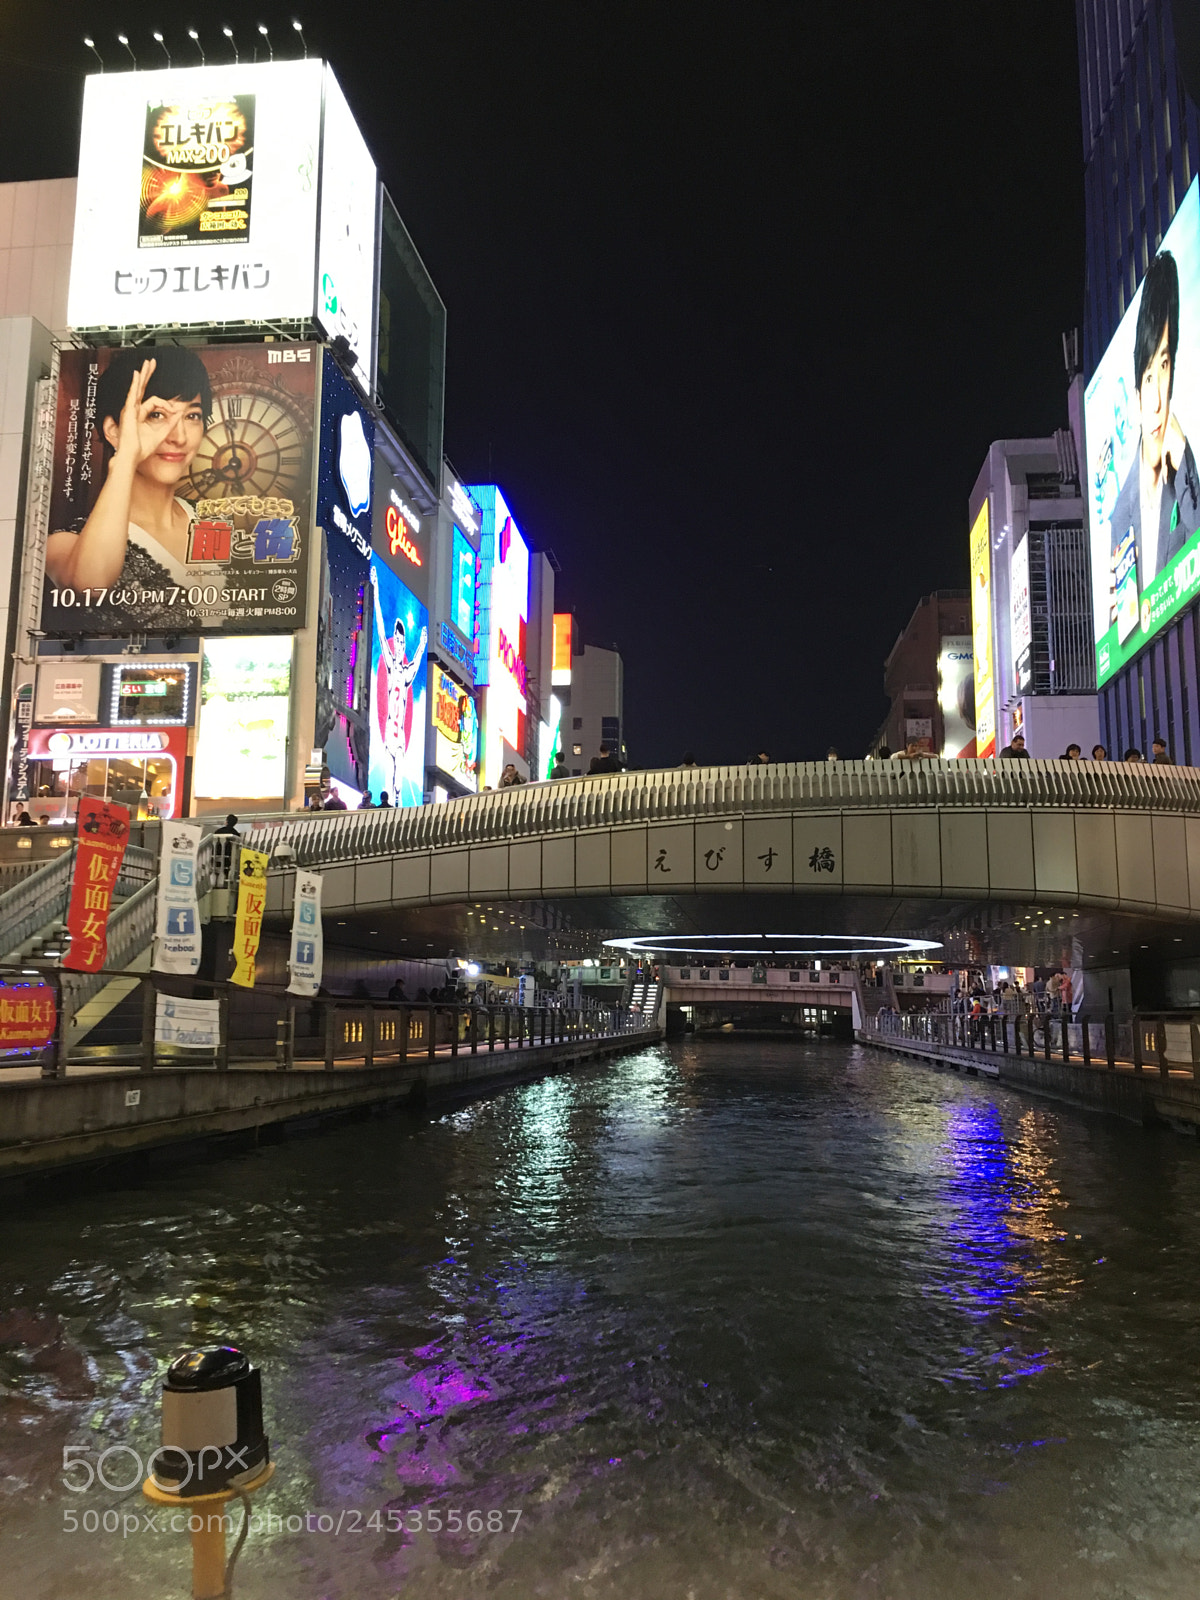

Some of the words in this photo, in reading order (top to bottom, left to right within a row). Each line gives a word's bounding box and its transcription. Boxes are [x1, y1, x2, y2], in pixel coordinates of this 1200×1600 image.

[159, 121, 239, 145] エレキバン
[268, 349, 311, 363] MBS
[81, 363, 98, 484] 見た目は変わりませんが、
[63, 399, 80, 502] 見る目が変わります。
[196, 495, 294, 517] 教えてもらう
[333, 504, 373, 561] メグミルク
[386, 505, 422, 567] Glico
[221, 588, 268, 601] START
[72, 732, 163, 750] LOTTERIA
[654, 847, 836, 873] えびす橋
[82, 854, 109, 965] 仮面女子
[0, 999, 53, 1023] 仮面女子
